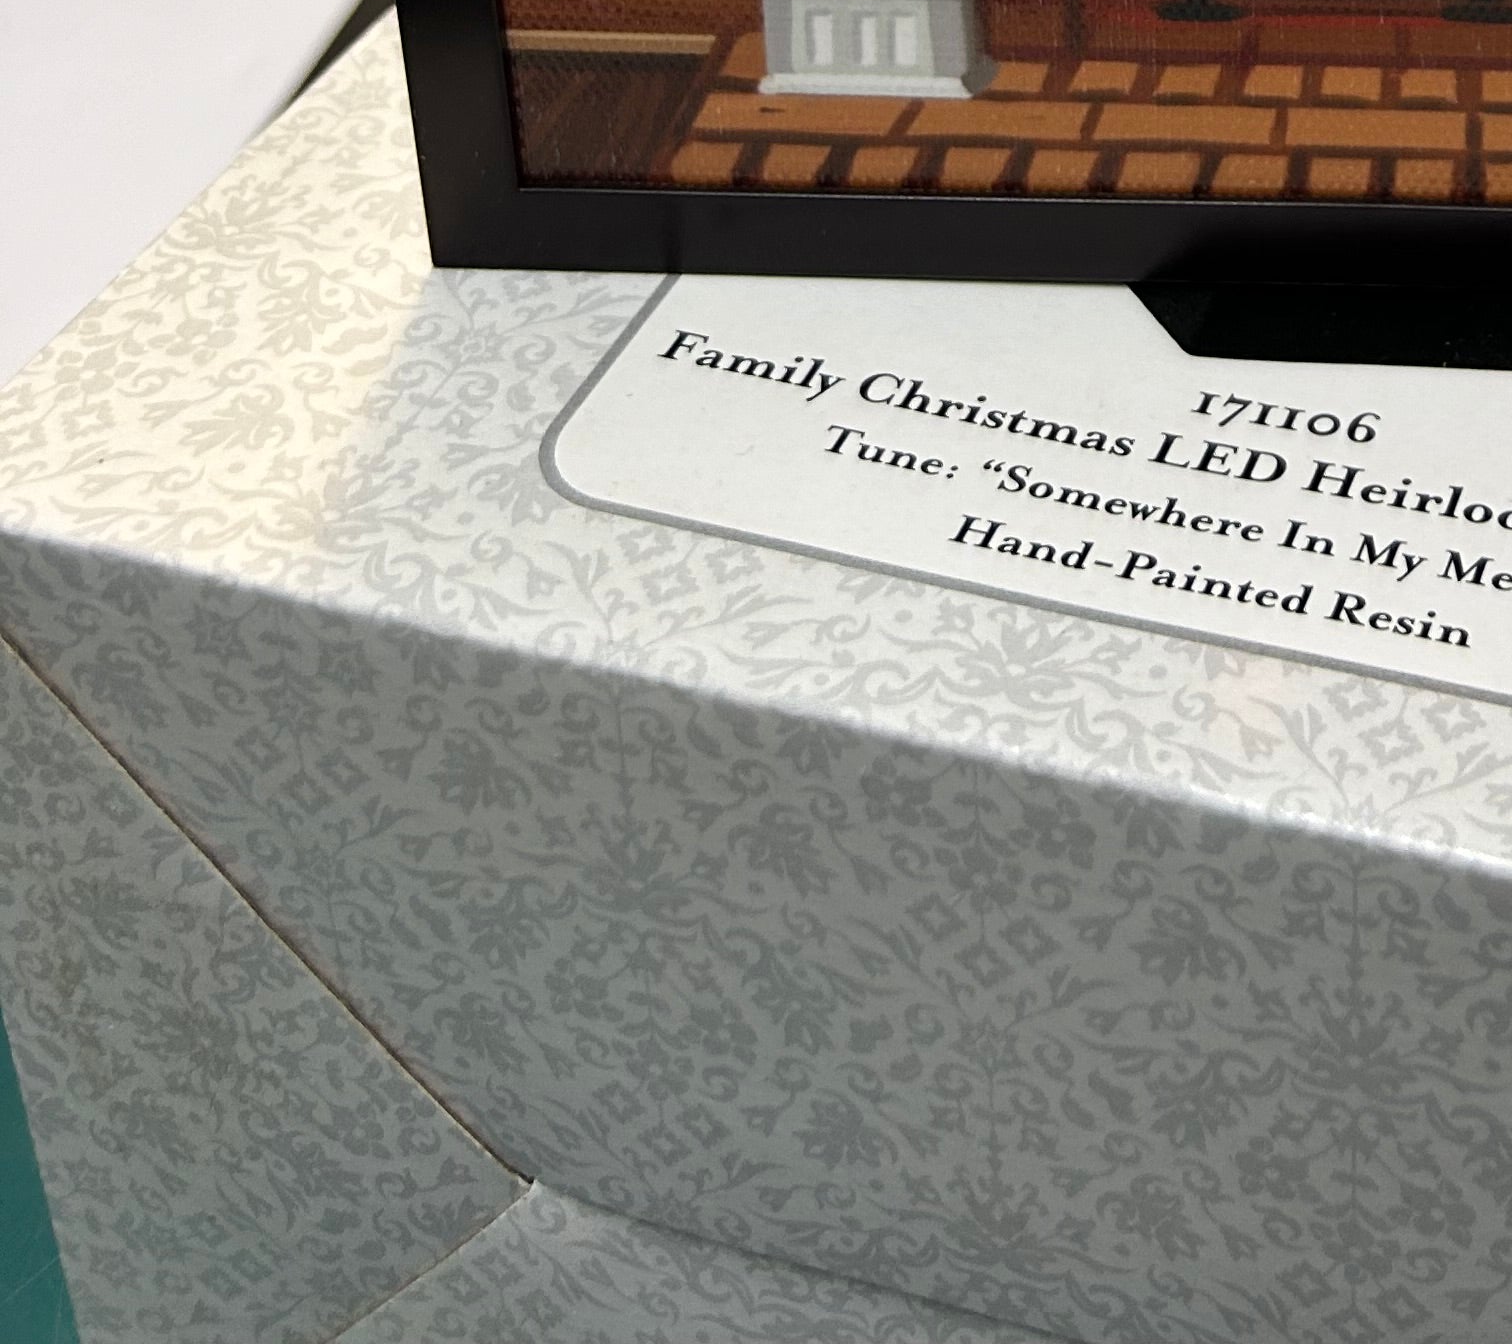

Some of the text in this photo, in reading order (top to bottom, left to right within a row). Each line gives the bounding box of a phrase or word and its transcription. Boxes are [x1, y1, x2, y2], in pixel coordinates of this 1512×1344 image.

[657, 329, 846, 403] Family
[858, 372, 1135, 458] Christmas
[1147, 431, 1288, 483] LED
[1192, 391, 1382, 444] 171106
[825, 424, 960, 480] Tune:
[982, 458, 1265, 543] “Somewhere
[1279, 519, 1335, 558] In
[1351, 532, 1426, 583] My
[948, 514, 1471, 649] Hand-Painted Resin
